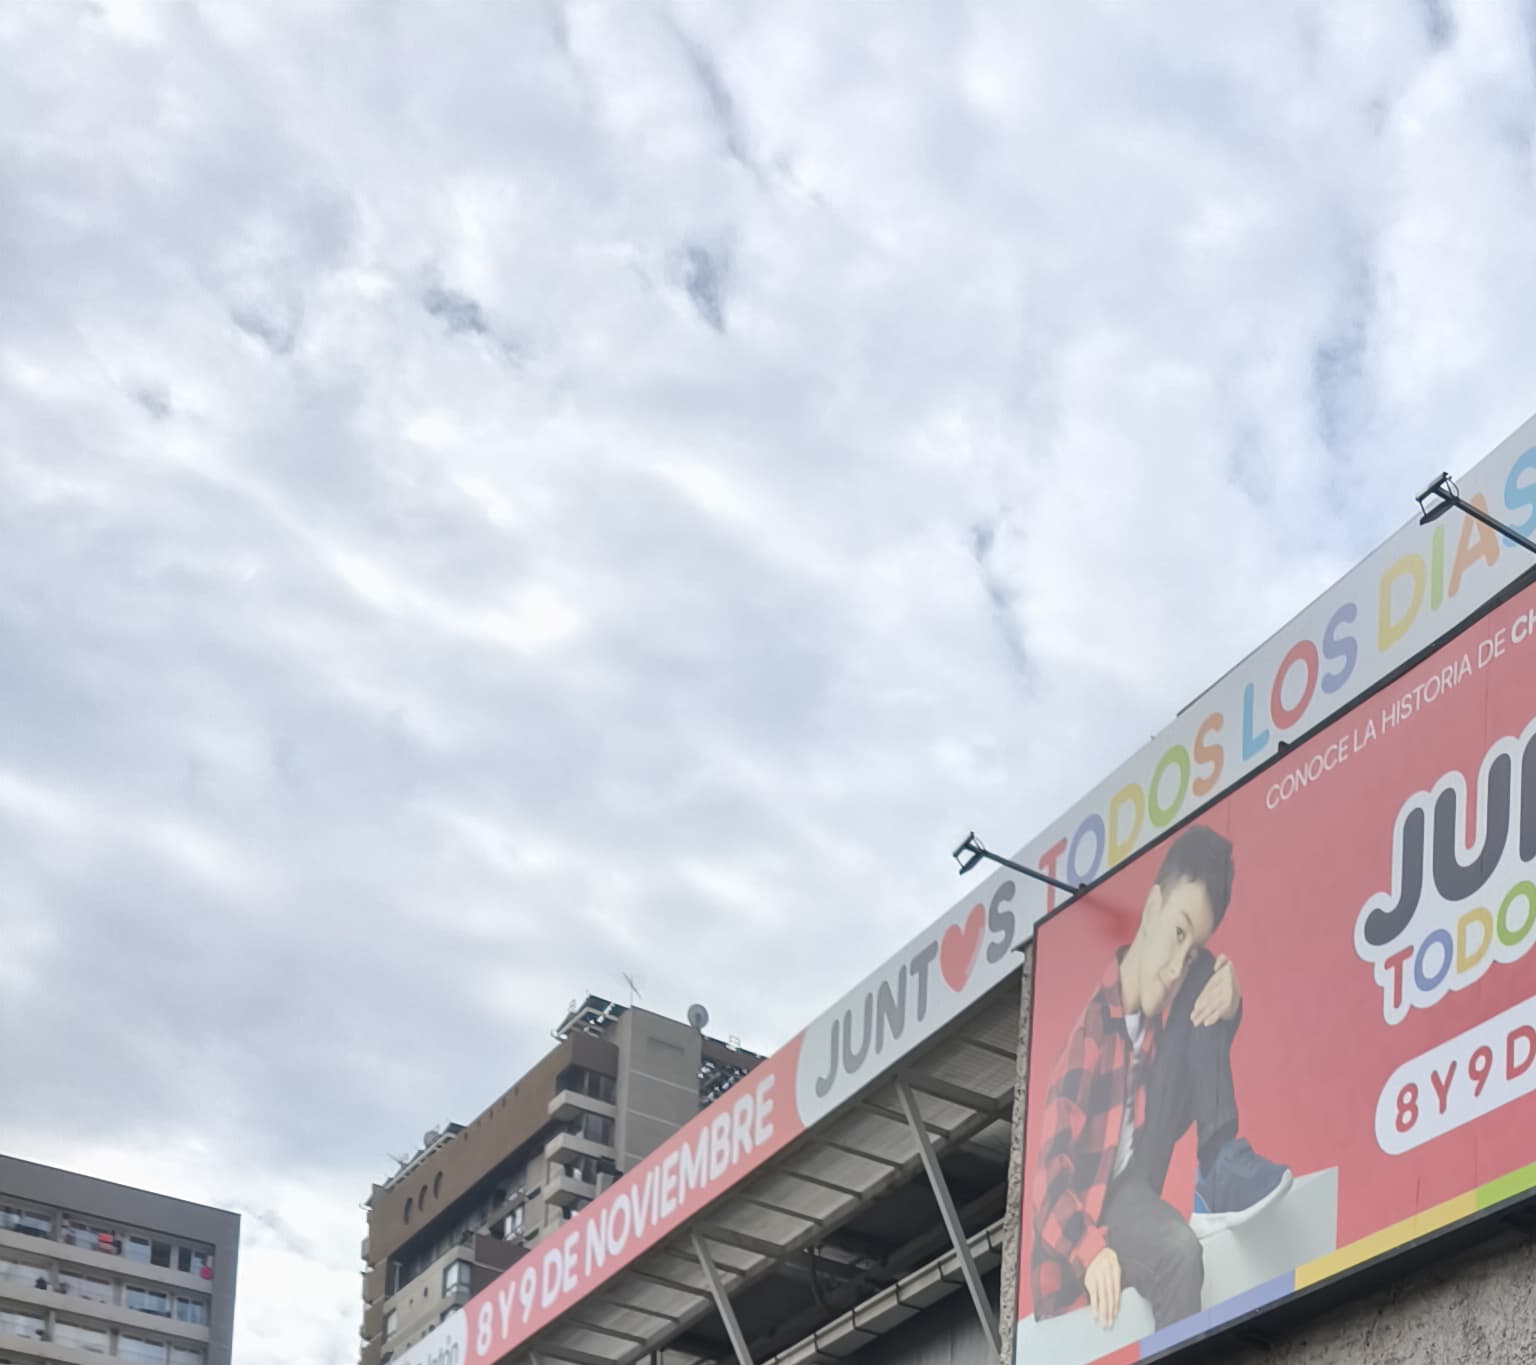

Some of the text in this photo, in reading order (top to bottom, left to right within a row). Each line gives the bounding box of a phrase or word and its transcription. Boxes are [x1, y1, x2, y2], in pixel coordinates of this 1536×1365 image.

[1038, 711, 1225, 910] TODOS
[1241, 602, 1359, 762] LOS
[1265, 735, 1349, 810] CONOCE
[1352, 719, 1377, 753] LA
[1381, 661, 1473, 735] HISTORIA
[1477, 628, 1506, 669] DE
[1394, 1082, 1419, 1133] 8
[1429, 1058, 1458, 1115] Y
[1467, 1044, 1493, 1098] 9
[475, 1073, 775, 1357] 8 Y 9 DE NOVIEMBRE
